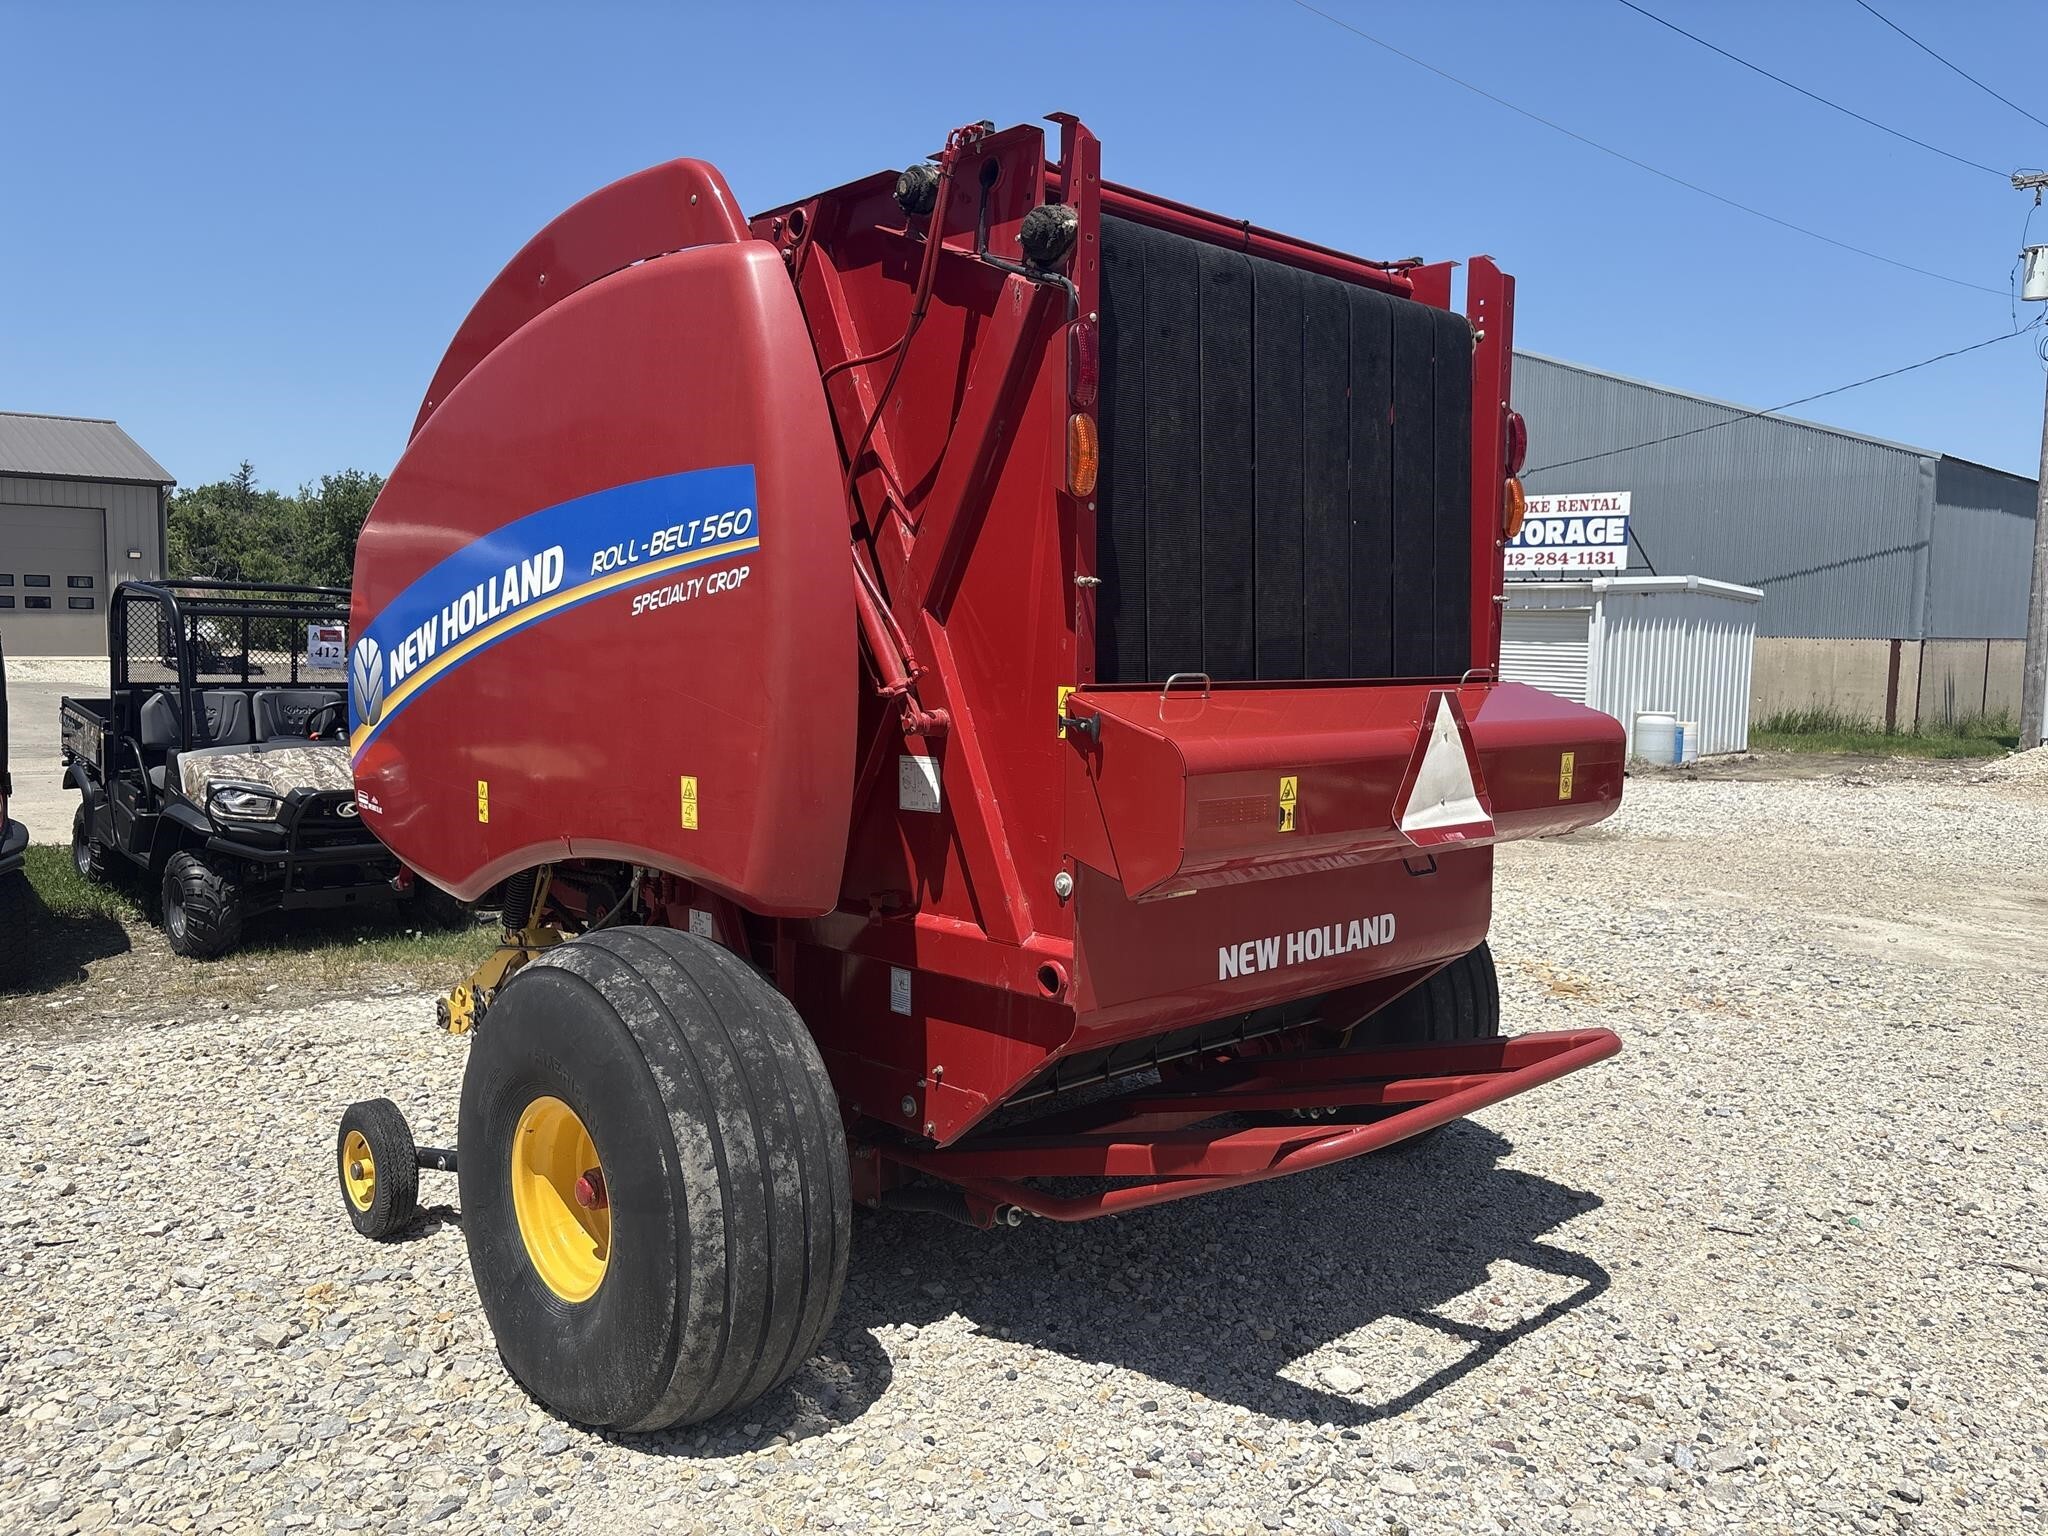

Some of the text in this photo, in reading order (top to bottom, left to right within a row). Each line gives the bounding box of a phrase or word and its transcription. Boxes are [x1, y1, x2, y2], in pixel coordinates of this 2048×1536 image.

[700, 507, 752, 544] 560
[1557, 498, 1621, 513] RENTAL
[1504, 551, 1616, 566] 12-284-1131
[631, 565, 750, 616] SPECIALTY CROP
[389, 545, 564, 689] NEW HOLLAND
[1218, 912, 1397, 981] NEW HOLLAND
